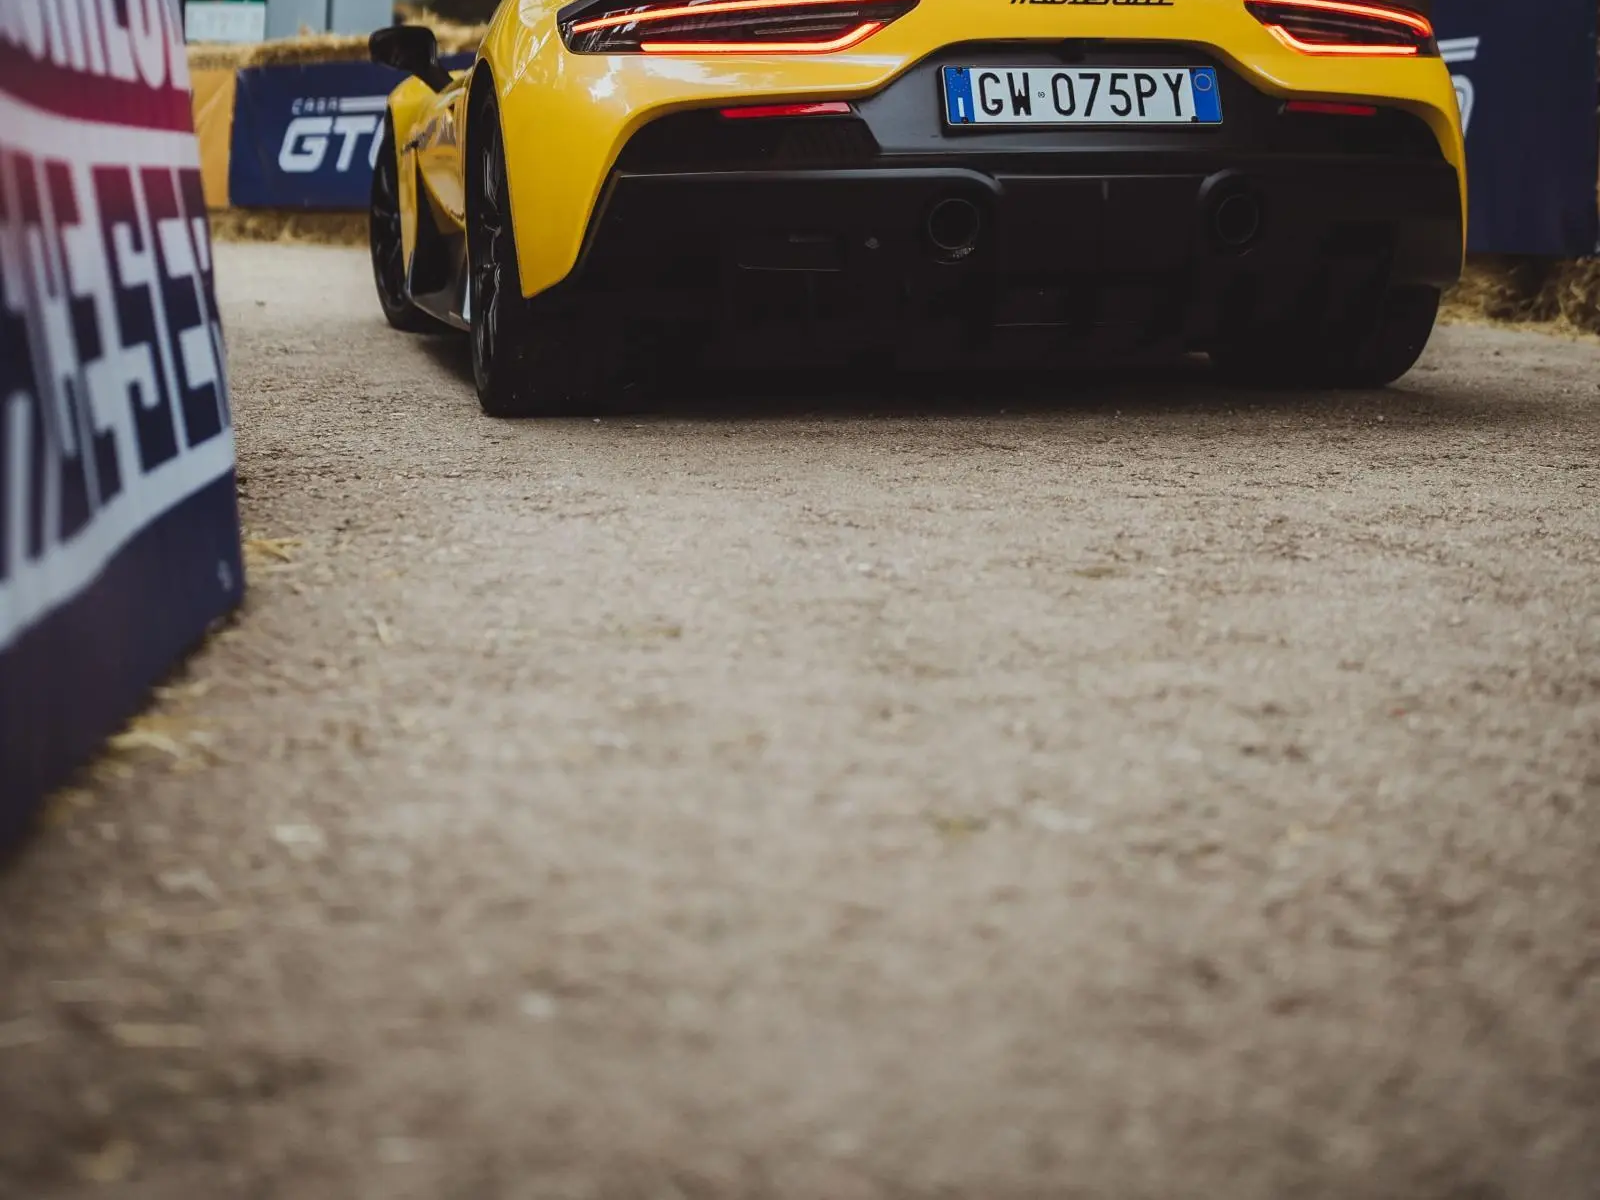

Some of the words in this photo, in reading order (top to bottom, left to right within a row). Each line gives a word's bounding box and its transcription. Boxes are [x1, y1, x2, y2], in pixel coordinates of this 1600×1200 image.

[978, 72, 1032, 117] GW
[1051, 72, 1184, 117] 075PY
[278, 114, 385, 173] GT
